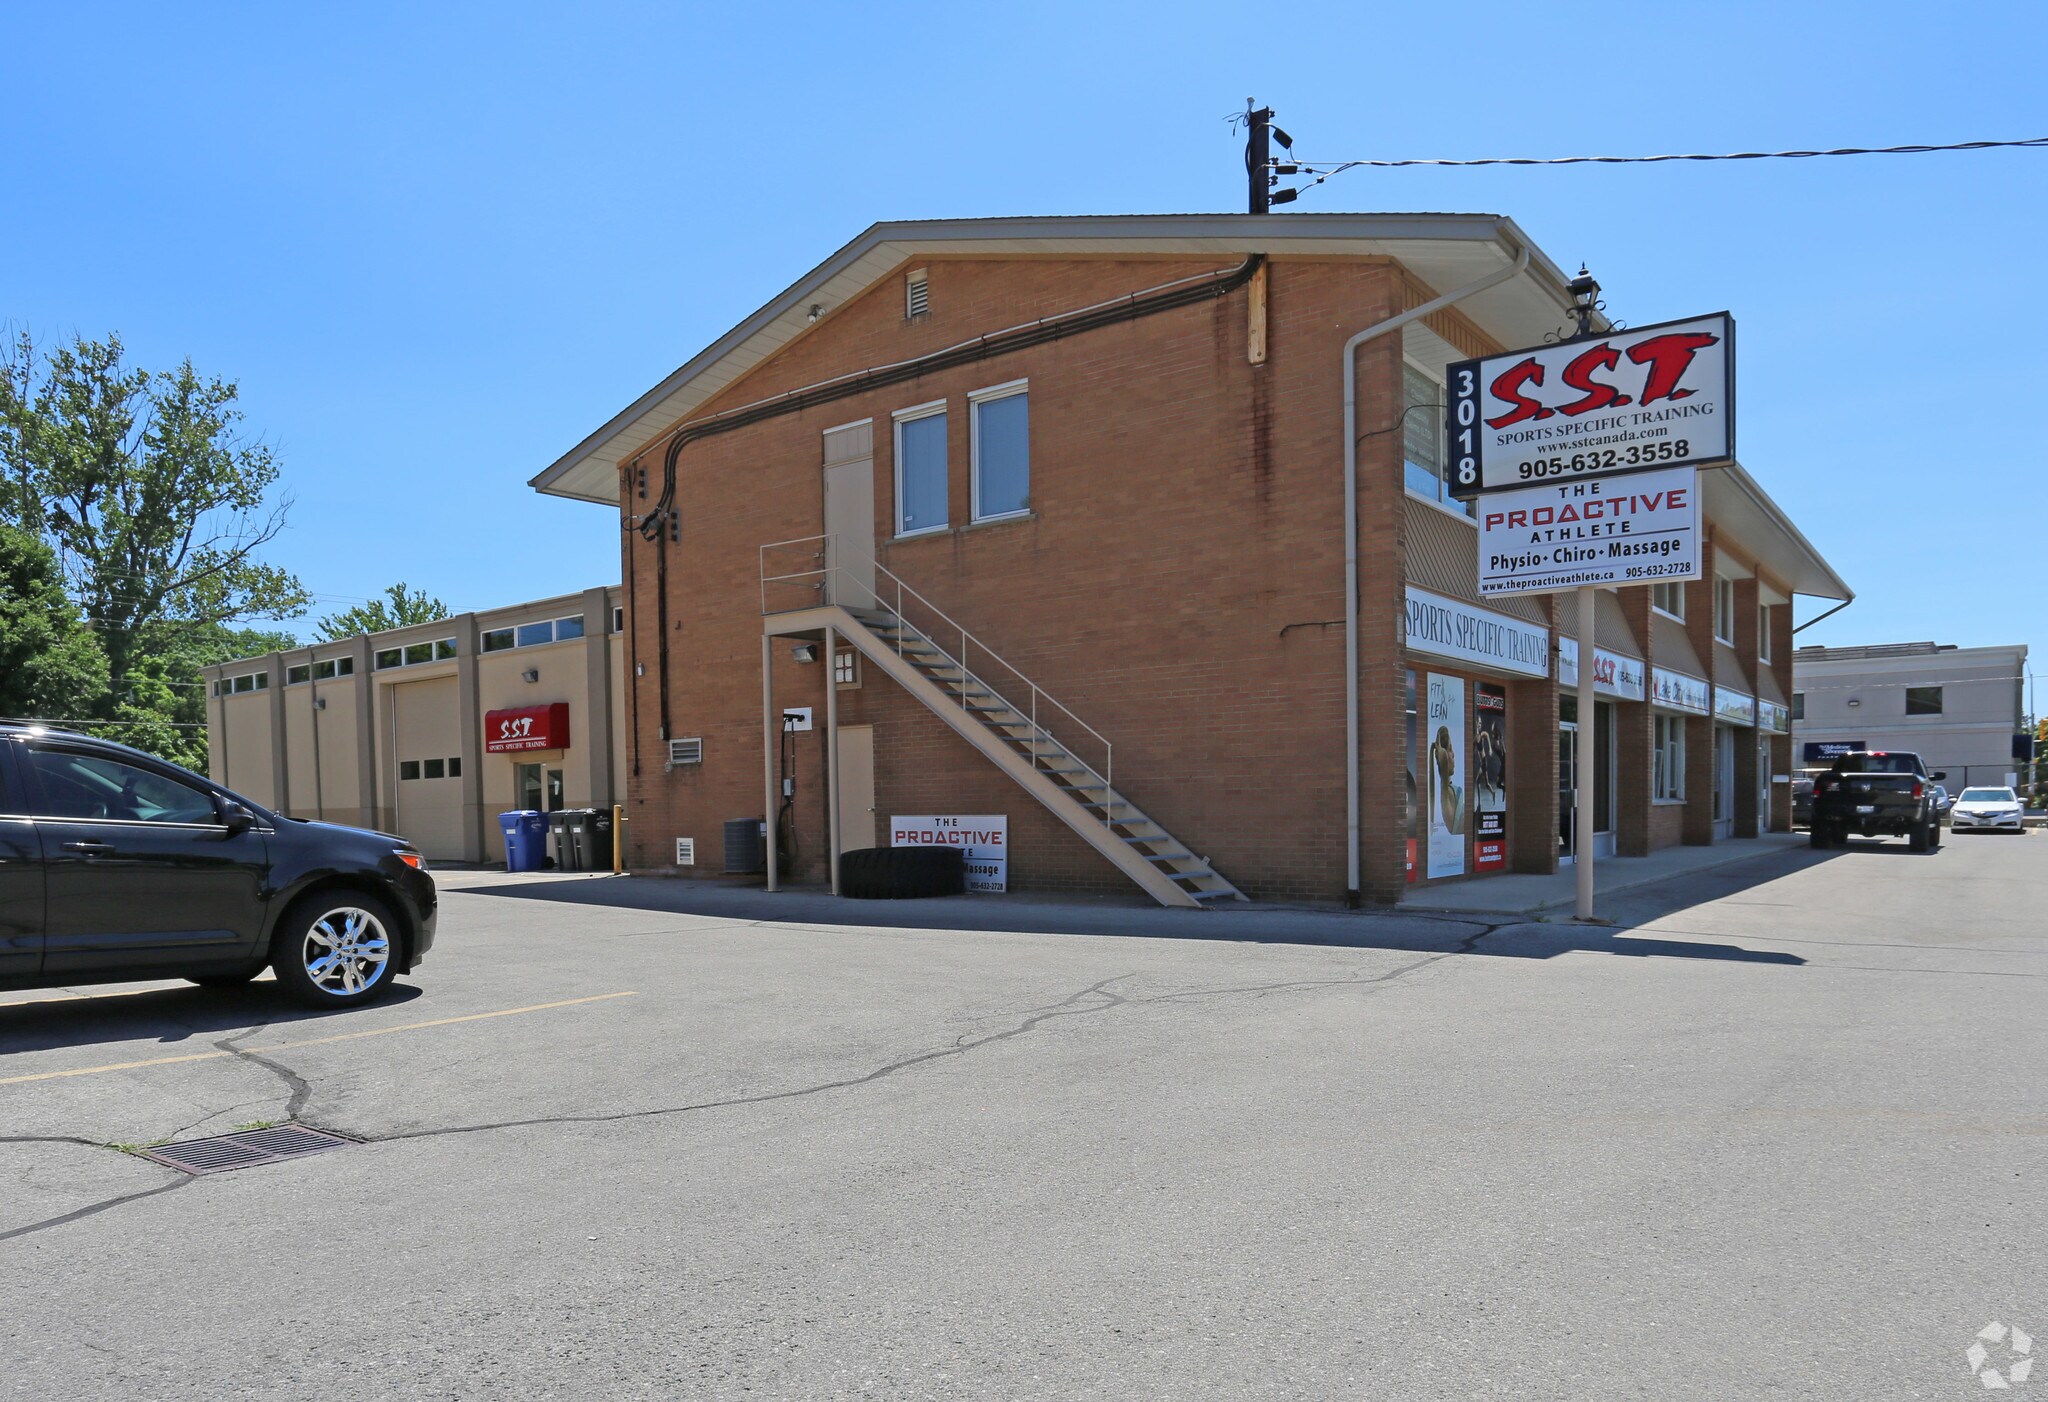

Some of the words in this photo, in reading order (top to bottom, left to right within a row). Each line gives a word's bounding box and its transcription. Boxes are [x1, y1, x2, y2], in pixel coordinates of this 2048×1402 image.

[1457, 370, 1476, 485] 3018
[1497, 427, 1553, 446] SPORTS
[1556, 416, 1627, 437] SPECIFIC
[1631, 402, 1714, 425] TRAINING
[1537, 427, 1668, 453] www.sstcanada.com
[1518, 439, 1690, 479] 905-632-3558
[1559, 482, 1600, 498] THE
[1485, 489, 1688, 532] PROACTIVE
[1530, 521, 1631, 544] ATHLETE
[1490, 551, 1541, 572] Physio
[1553, 546, 1596, 564] Chiro
[1608, 539, 1681, 557] Massage
[1481, 571, 1615, 592] www.theproactiveathlete.ca
[1625, 562, 1691, 578] 905-632-2728
[1405, 598, 1452, 646] SPORTS
[1456, 612, 1505, 658] SPECIFIC
[1507, 628, 1547, 668] TRAINING
[1430, 682, 1441, 698] FIT
[1430, 702, 1448, 720] LEAN
[506, 742, 524, 750] SPECIFIC
[935, 818, 958, 827] THE
[895, 830, 1003, 845] PROACTIVE
